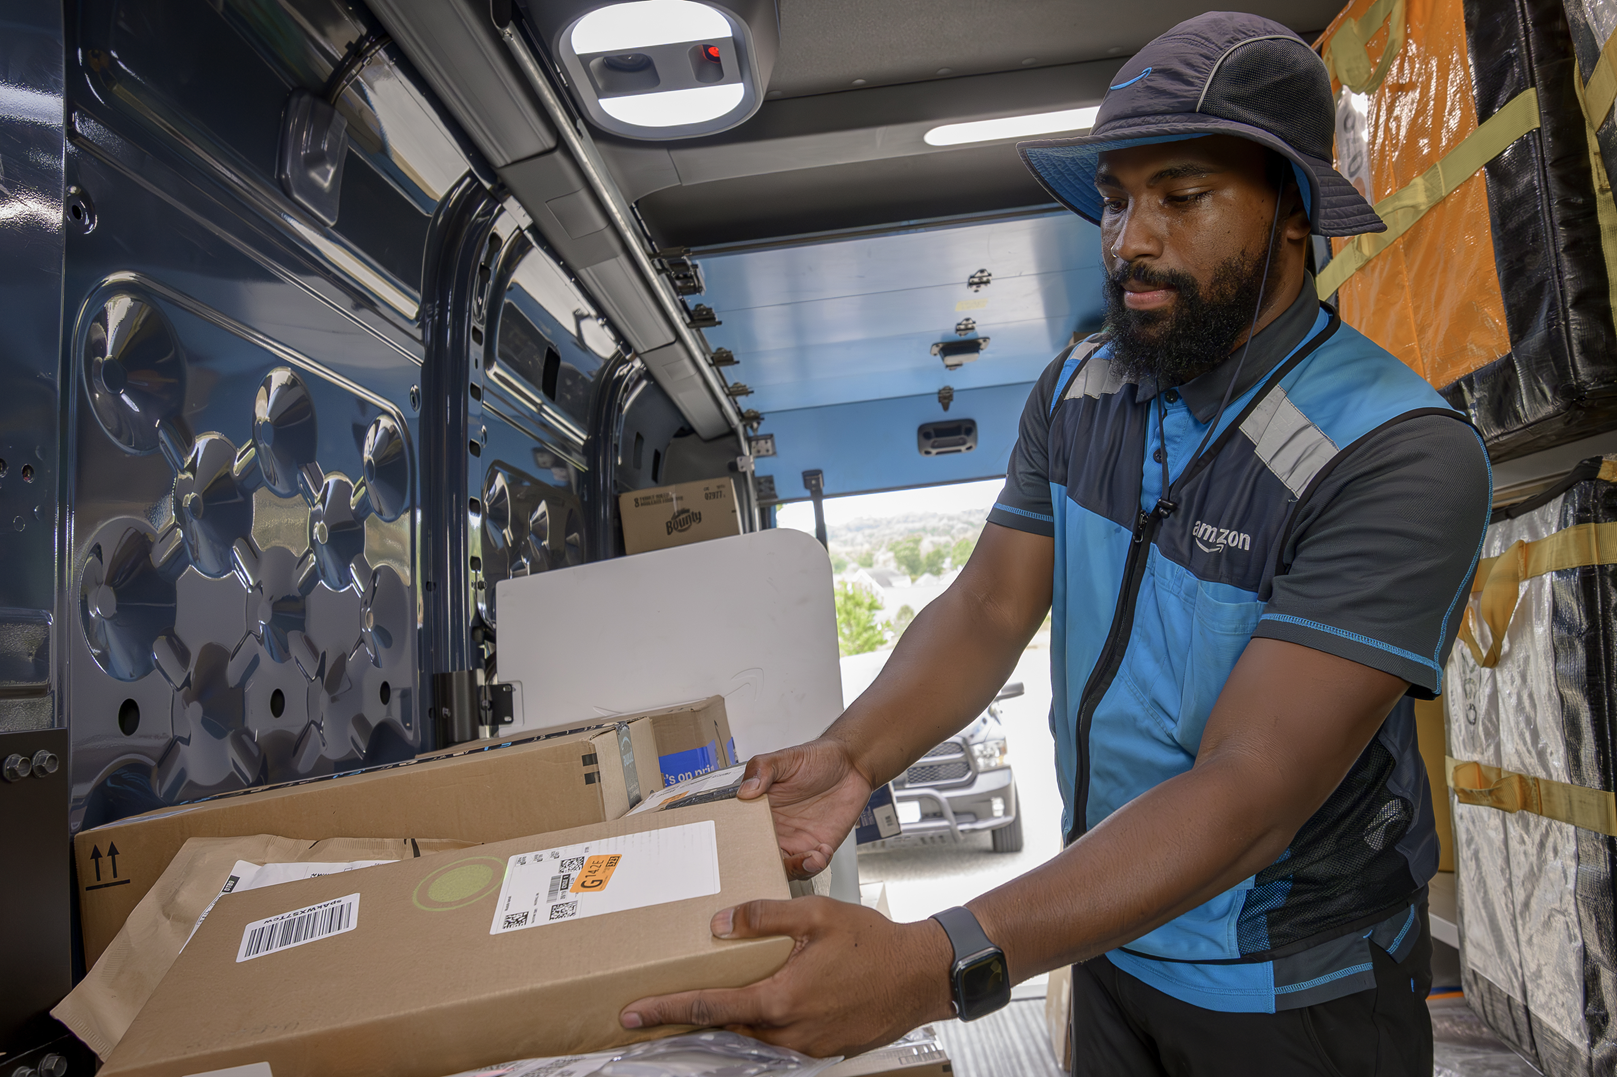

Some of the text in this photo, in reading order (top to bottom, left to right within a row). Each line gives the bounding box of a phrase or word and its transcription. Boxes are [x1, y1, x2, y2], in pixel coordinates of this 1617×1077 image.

[665, 511, 702, 536] Bounty
[1192, 520, 1251, 551] amzon
[678, 771, 693, 782] on
[580, 879, 603, 889] G
